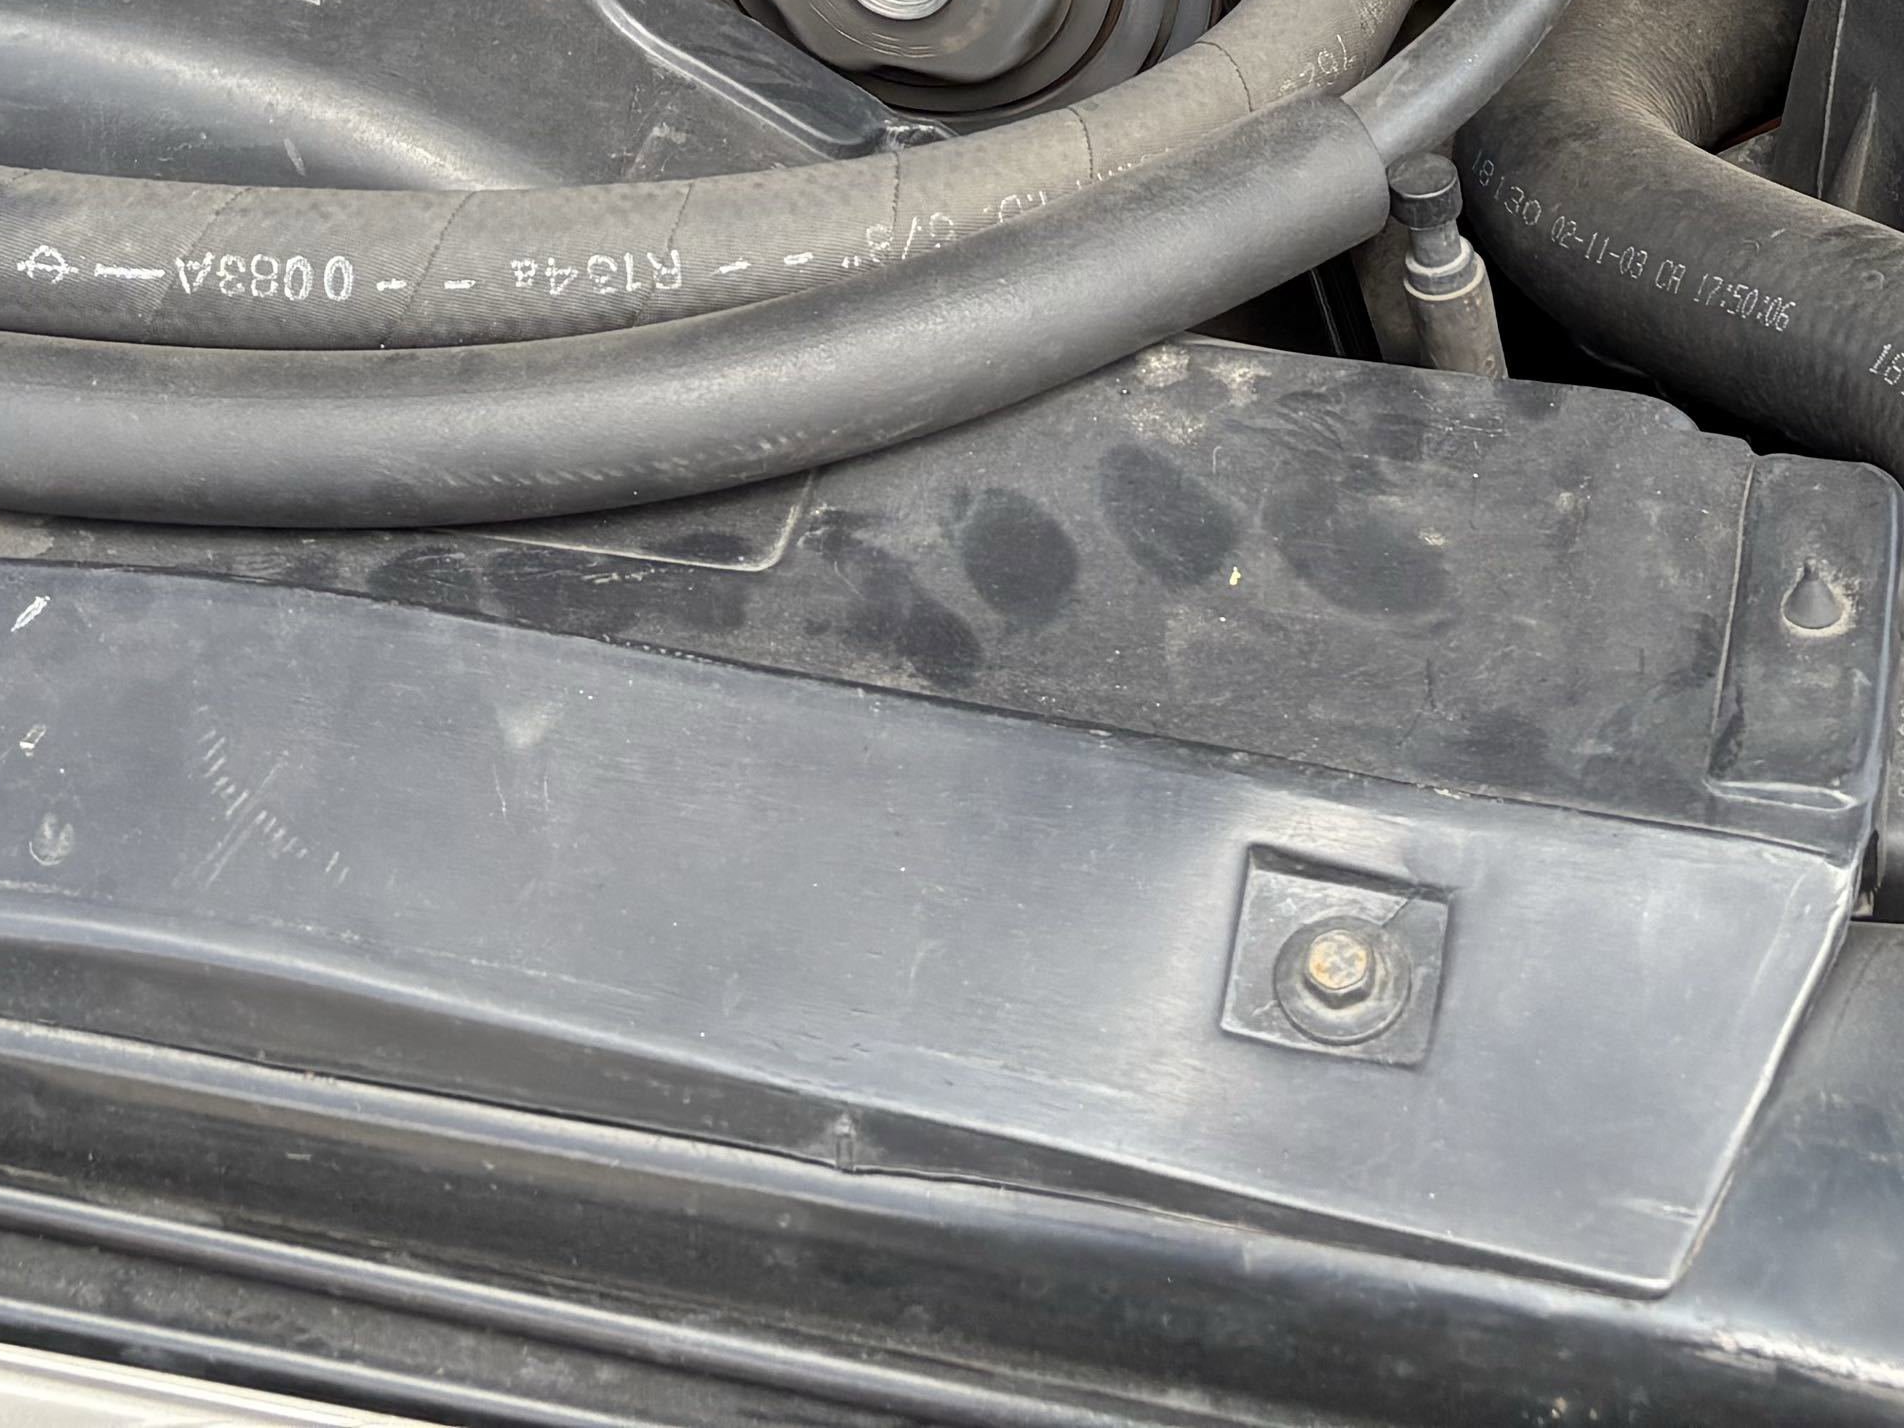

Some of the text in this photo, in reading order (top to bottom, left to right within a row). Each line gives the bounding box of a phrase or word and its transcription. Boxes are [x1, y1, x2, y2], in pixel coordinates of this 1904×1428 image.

[175, 251, 354, 302] 0083A
[1471, 149, 1542, 227] 18130
[1550, 215, 1648, 280] 02-11-03
[1693, 271, 1797, 332] 17:50:06
